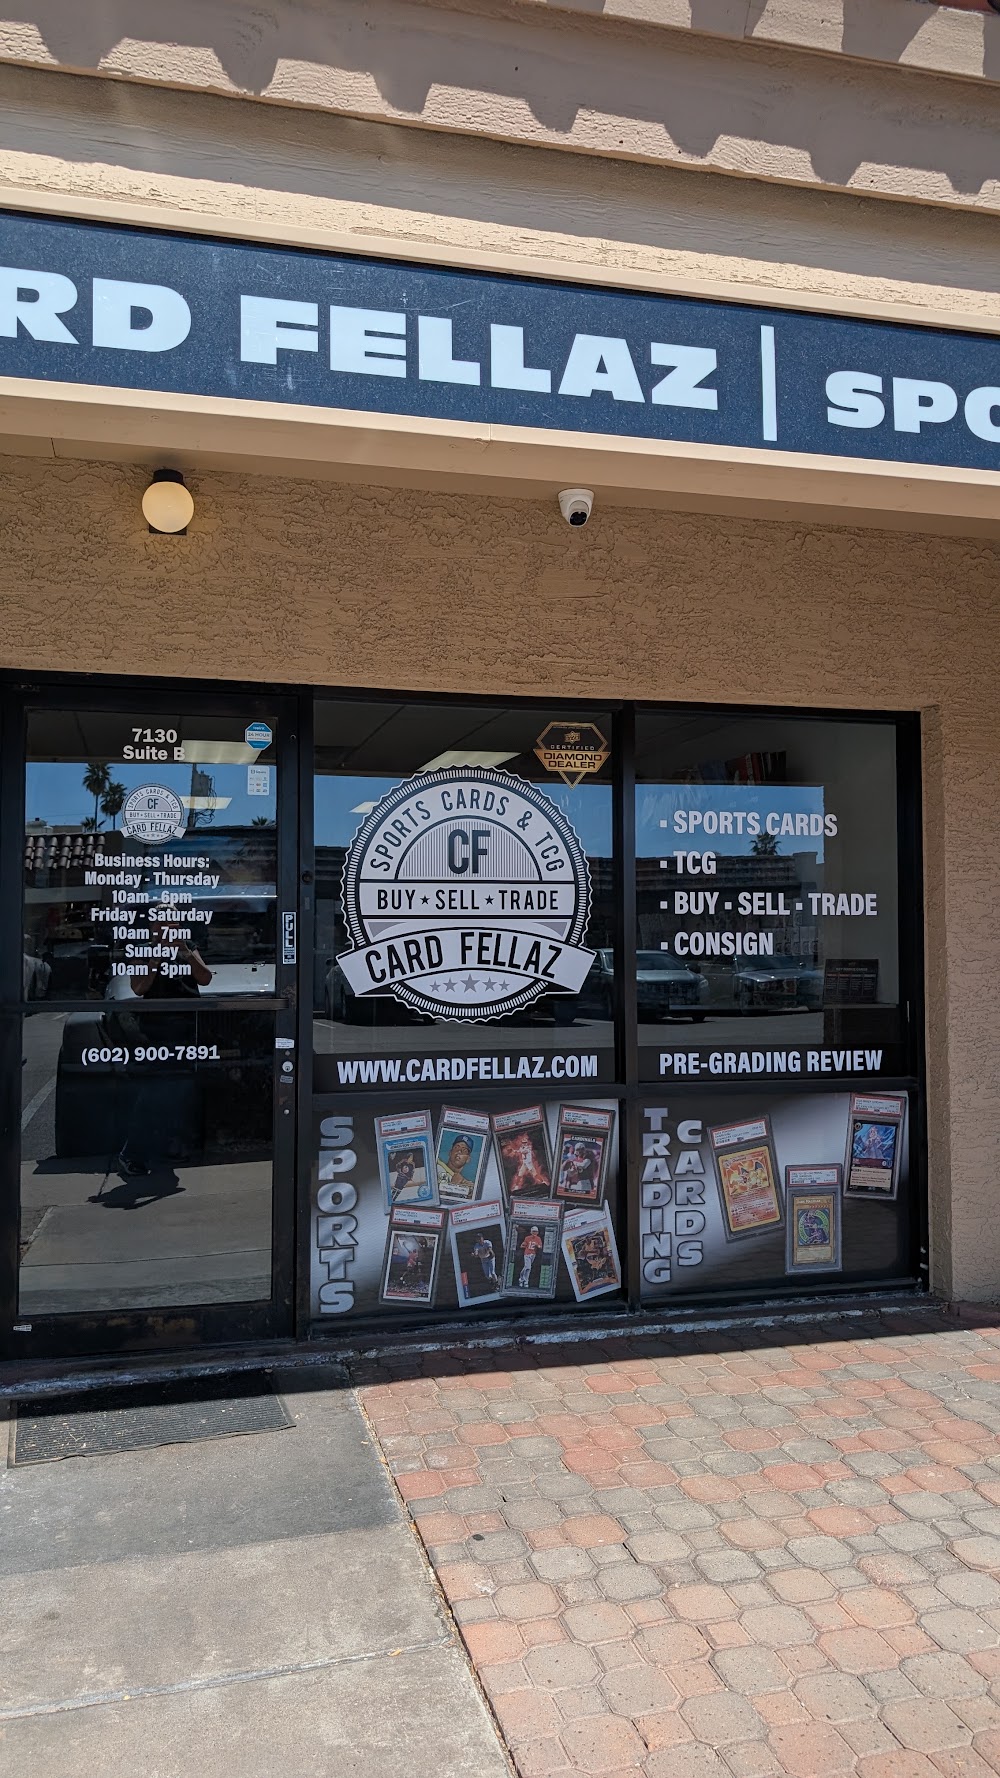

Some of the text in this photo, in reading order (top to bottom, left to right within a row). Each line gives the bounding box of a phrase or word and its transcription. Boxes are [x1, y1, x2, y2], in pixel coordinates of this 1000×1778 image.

[239, 295, 718, 411] FELLAZ
[131, 728, 178, 743] 7130
[122, 747, 186, 760] Suite B
[543, 752, 603, 761] DIAMOND
[548, 761, 596, 769] DEALER
[147, 798, 159, 810] CF
[126, 822, 178, 835] CARD FELLAZ
[370, 788, 565, 872] SPORTS CARDS & TCG
[673, 810, 838, 837] SPORTS CARDS
[94, 854, 209, 868] Business Hours:
[448, 829, 491, 874] CF
[673, 851, 717, 874] TCG
[85, 872, 141, 889] Monday
[153, 872, 219, 889] Thursday
[112, 890, 149, 904] 10am
[161, 891, 192, 907] 6pm
[377, 889, 559, 910] BUY SELL TRADE
[674, 891, 877, 915] BUY SELL TRADE
[91, 908, 137, 924] Friday
[148, 908, 213, 924] Saturday
[112, 927, 149, 940] 10am
[161, 927, 191, 943] 7pm
[285, 914, 294, 948] PULL
[125, 945, 179, 961] Sunday
[674, 932, 774, 955] CONSIGN
[364, 932, 564, 983] CARD FELLAZ
[112, 963, 149, 976] 10am
[161, 963, 191, 980] 3pm
[81, 1045, 220, 1065] (602) 900-7891
[659, 1050, 882, 1075] PRE-GRADING REVIEW
[337, 1055, 598, 1083] WWW.CARDFELLAZ.COM
[642, 1107, 672, 1284] TRADING
[675, 1119, 705, 1266] CARDS
[317, 1116, 358, 1314] SPORTS
